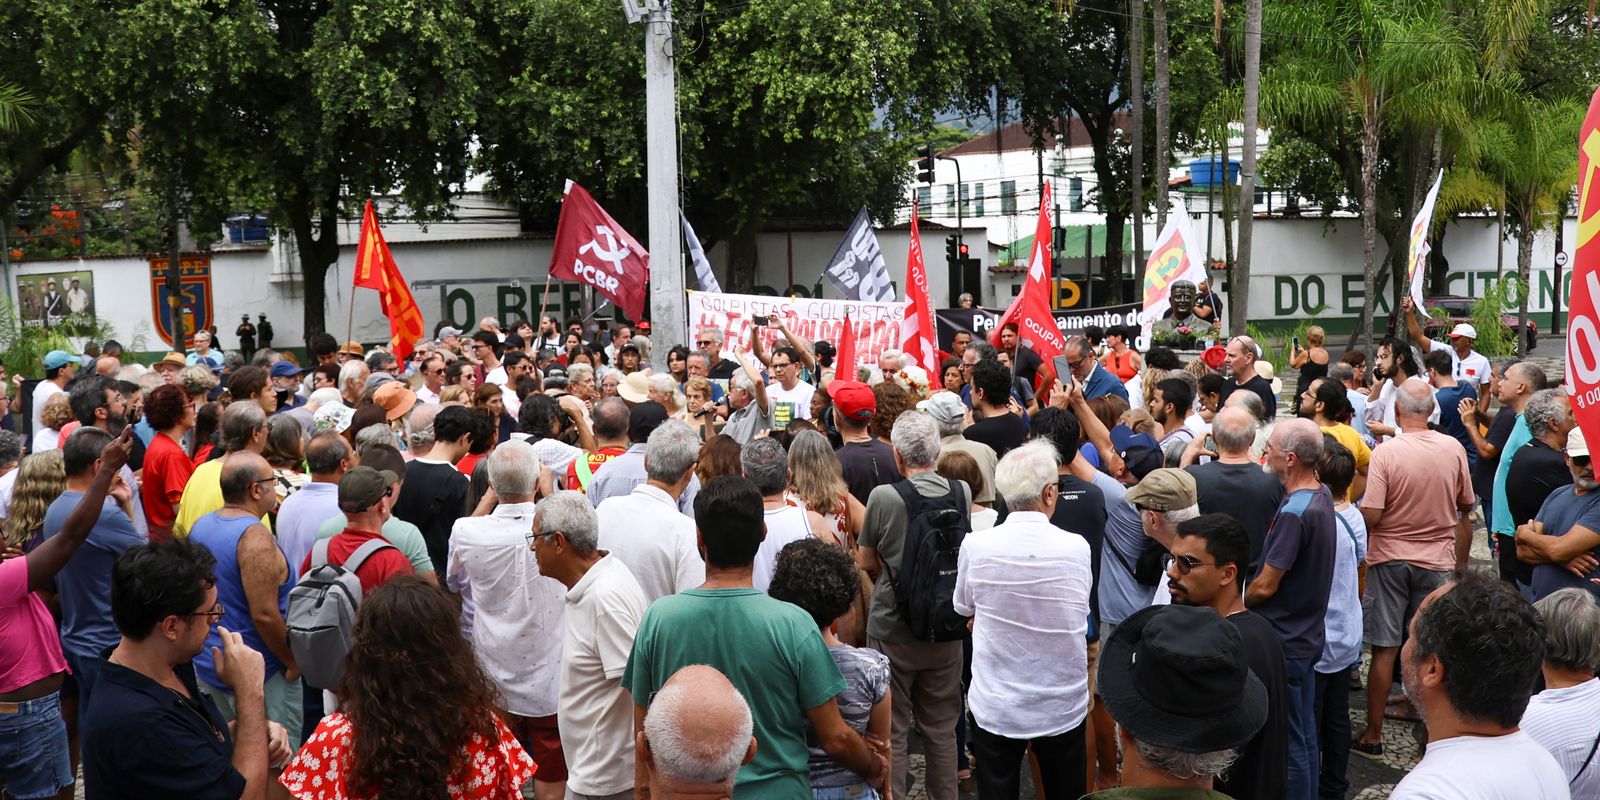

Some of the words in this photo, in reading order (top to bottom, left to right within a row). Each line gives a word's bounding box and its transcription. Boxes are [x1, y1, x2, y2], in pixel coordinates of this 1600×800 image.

[573, 258, 620, 296] PCBR
[1274, 274, 1325, 316] DO
[1342, 271, 1520, 314] EXCITO
[446, 288, 476, 335] O
[701, 296, 790, 319] GOLPISTAS
[808, 302, 904, 321] GOLPISTAS
[973, 314, 999, 332] Pel
[1053, 311, 1122, 330] amento
